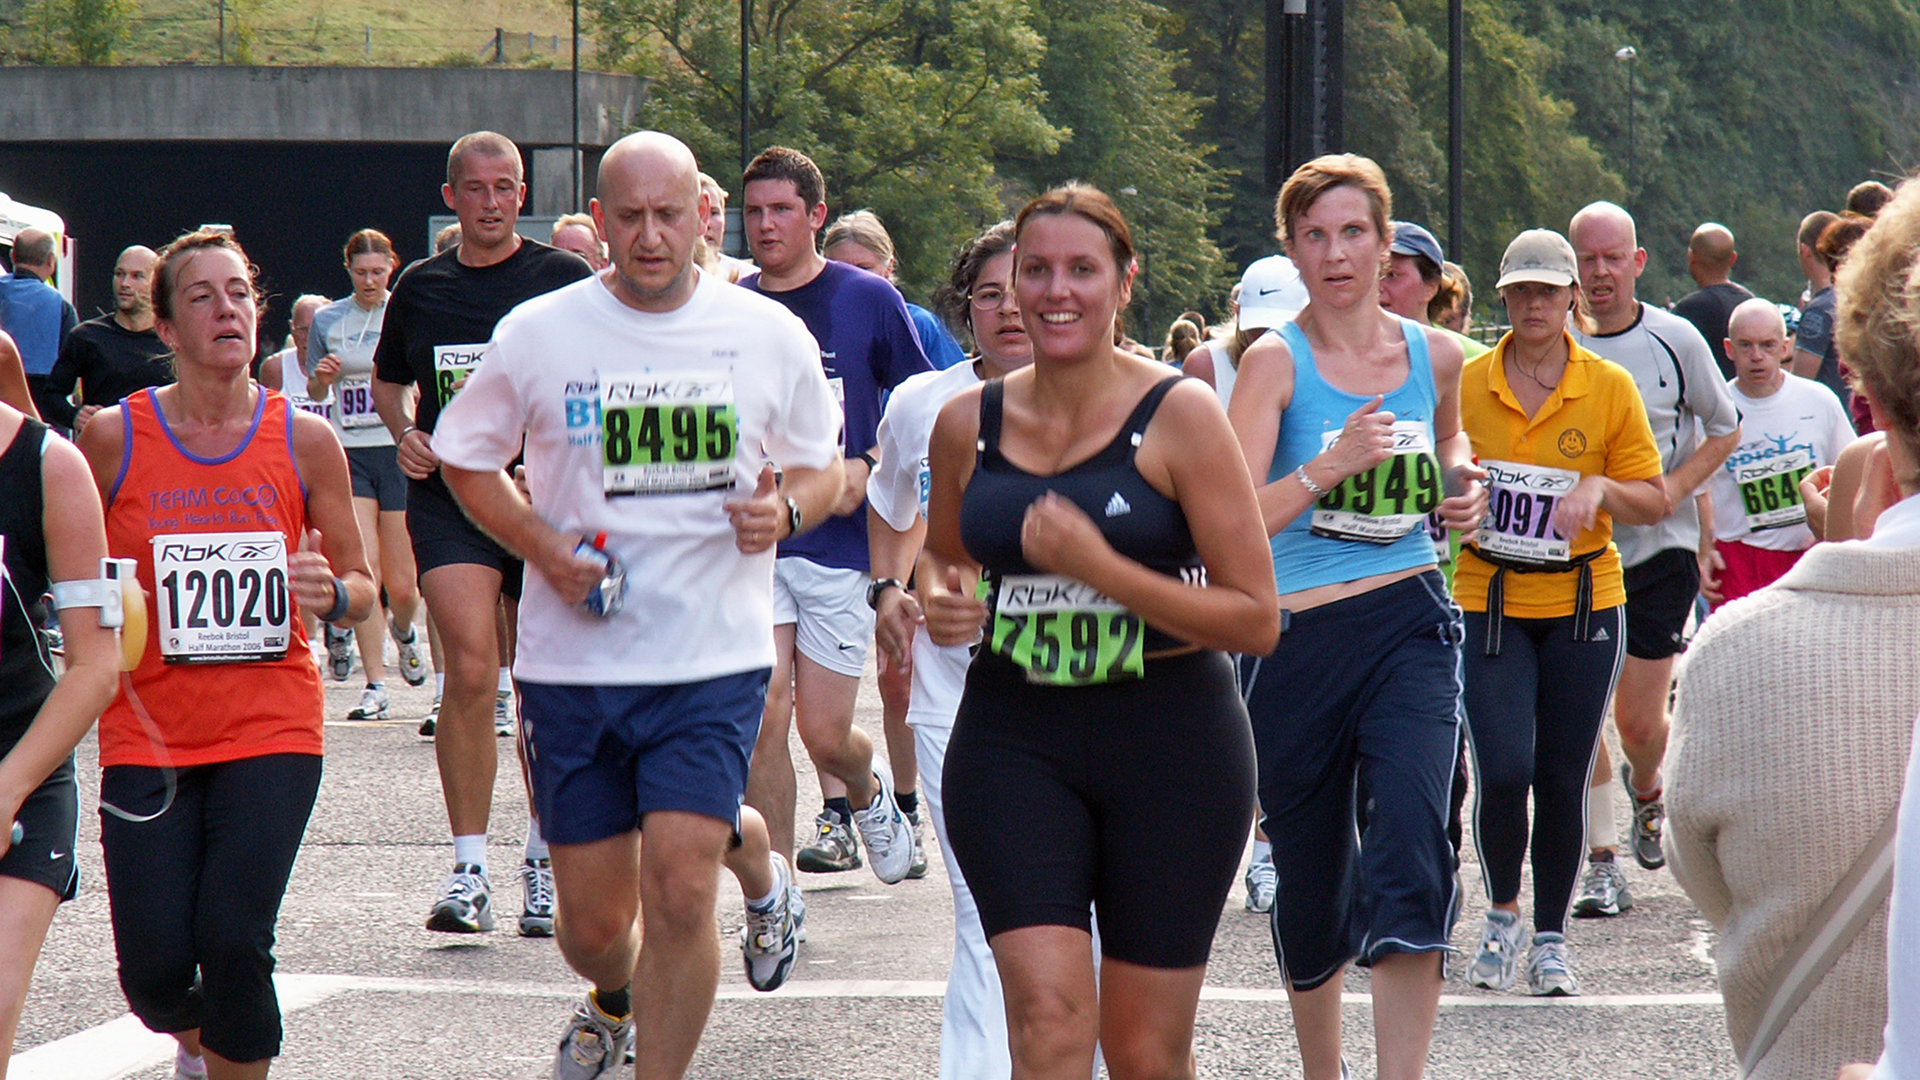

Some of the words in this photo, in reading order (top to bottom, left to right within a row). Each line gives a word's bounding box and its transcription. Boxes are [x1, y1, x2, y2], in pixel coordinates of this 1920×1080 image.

[439, 351, 485, 367] RbK
[607, 380, 672, 401] RbK
[605, 404, 731, 466] 8495
[148, 487, 208, 511] TEAM
[184, 511, 225, 525] Hearts
[228, 509, 251, 524] Run
[1482, 488, 1566, 541] 097
[161, 543, 229, 562] RbK
[161, 567, 287, 630] 12020
[1007, 583, 1076, 606] RbK
[198, 632, 224, 641] Reebok
[225, 630, 250, 640] Bristol
[1000, 611, 1140, 682] 7592
[188, 645, 205, 653] Half
[206, 643, 242, 652] Marathon
[242, 642, 262, 651] 2006
